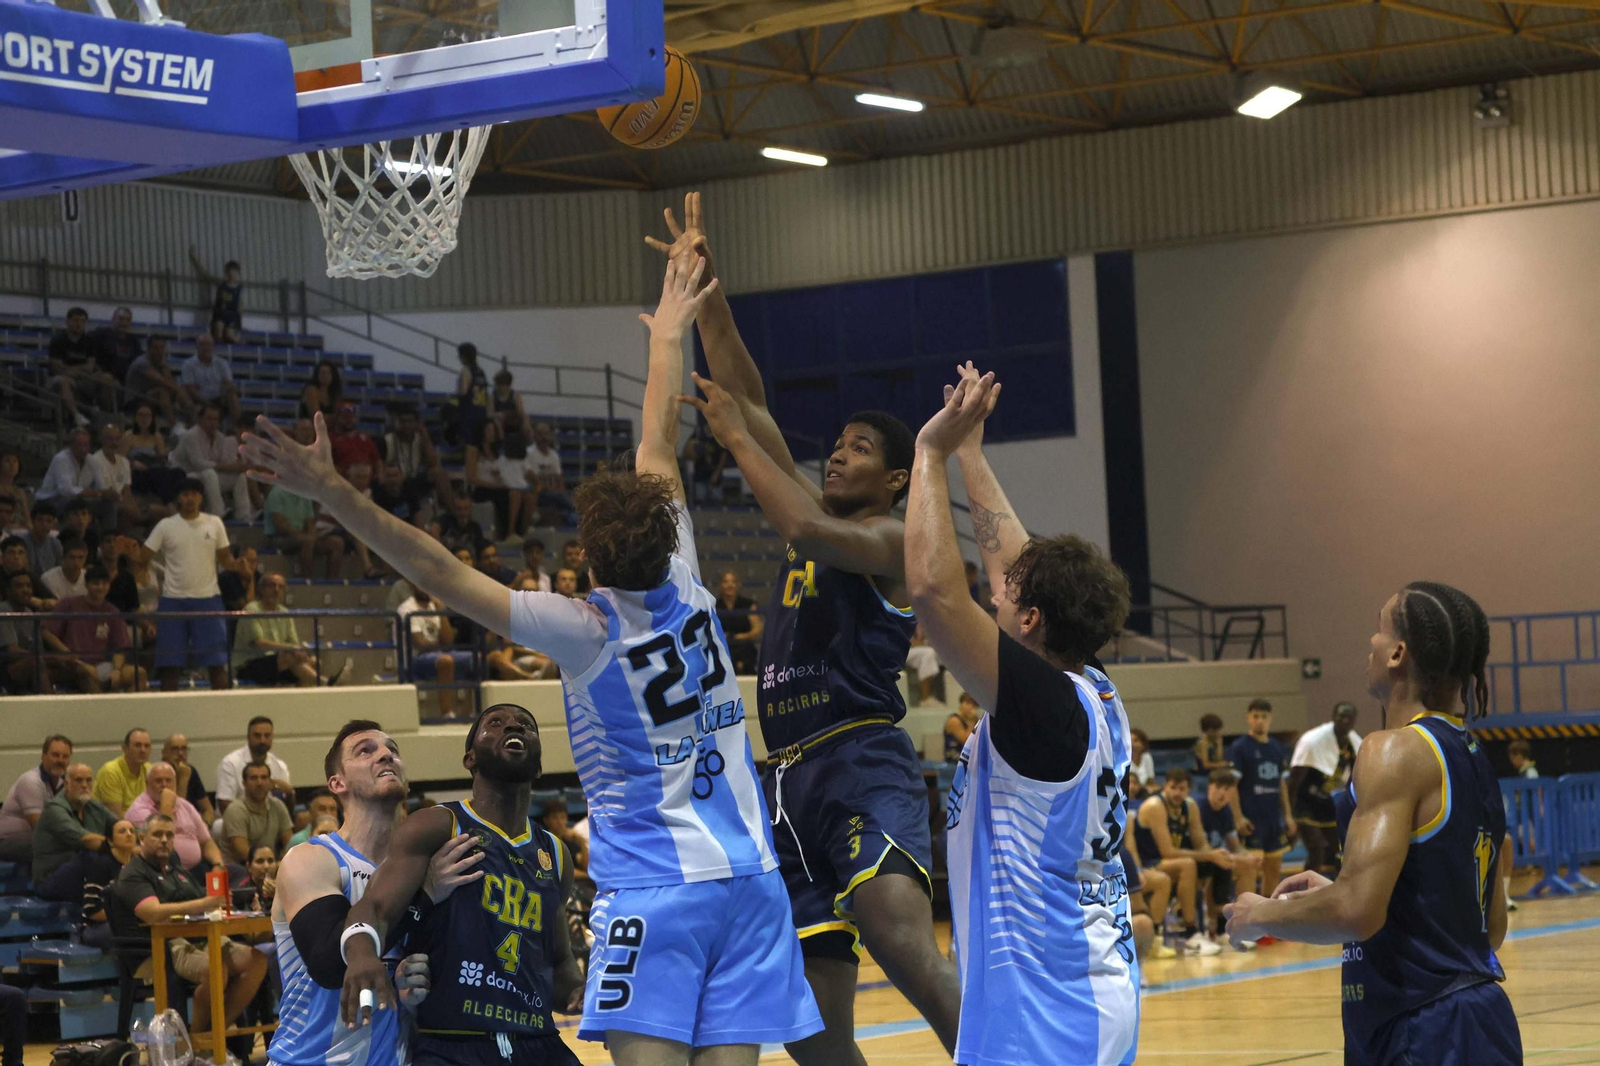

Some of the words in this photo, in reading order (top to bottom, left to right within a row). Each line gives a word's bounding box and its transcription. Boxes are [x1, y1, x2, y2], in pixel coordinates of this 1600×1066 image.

[0, 32, 75, 74] ORT
[78, 43, 214, 93] SYSTEM
[626, 608, 727, 729] 23
[655, 736, 695, 766] LA
[847, 835, 861, 860] 3
[482, 873, 542, 933] CBA
[495, 930, 522, 975] 4
[595, 915, 647, 1013] ULB
[463, 999, 544, 1029] ALGECIRAS
